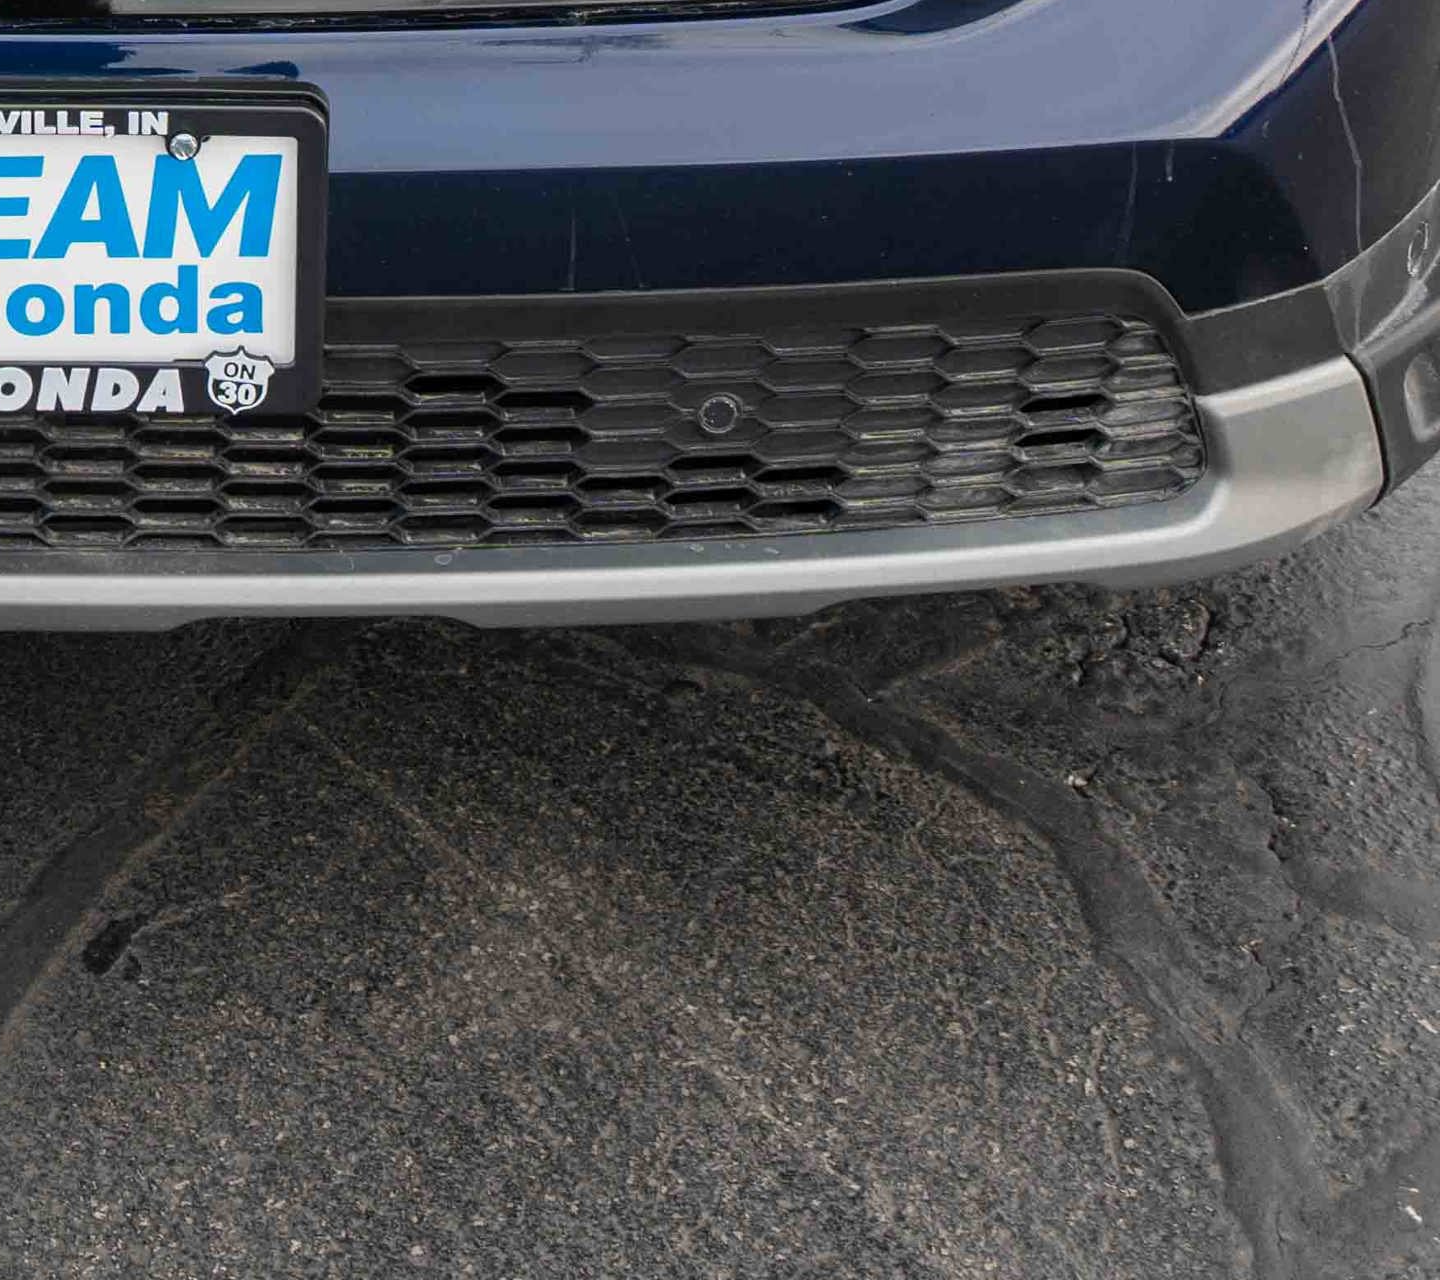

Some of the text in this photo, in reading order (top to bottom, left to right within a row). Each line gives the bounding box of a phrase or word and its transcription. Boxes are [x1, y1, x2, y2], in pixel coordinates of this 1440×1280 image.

[127, 110, 169, 136] IN
[223, 361, 257, 381] ON
[216, 382, 256, 406] 30
